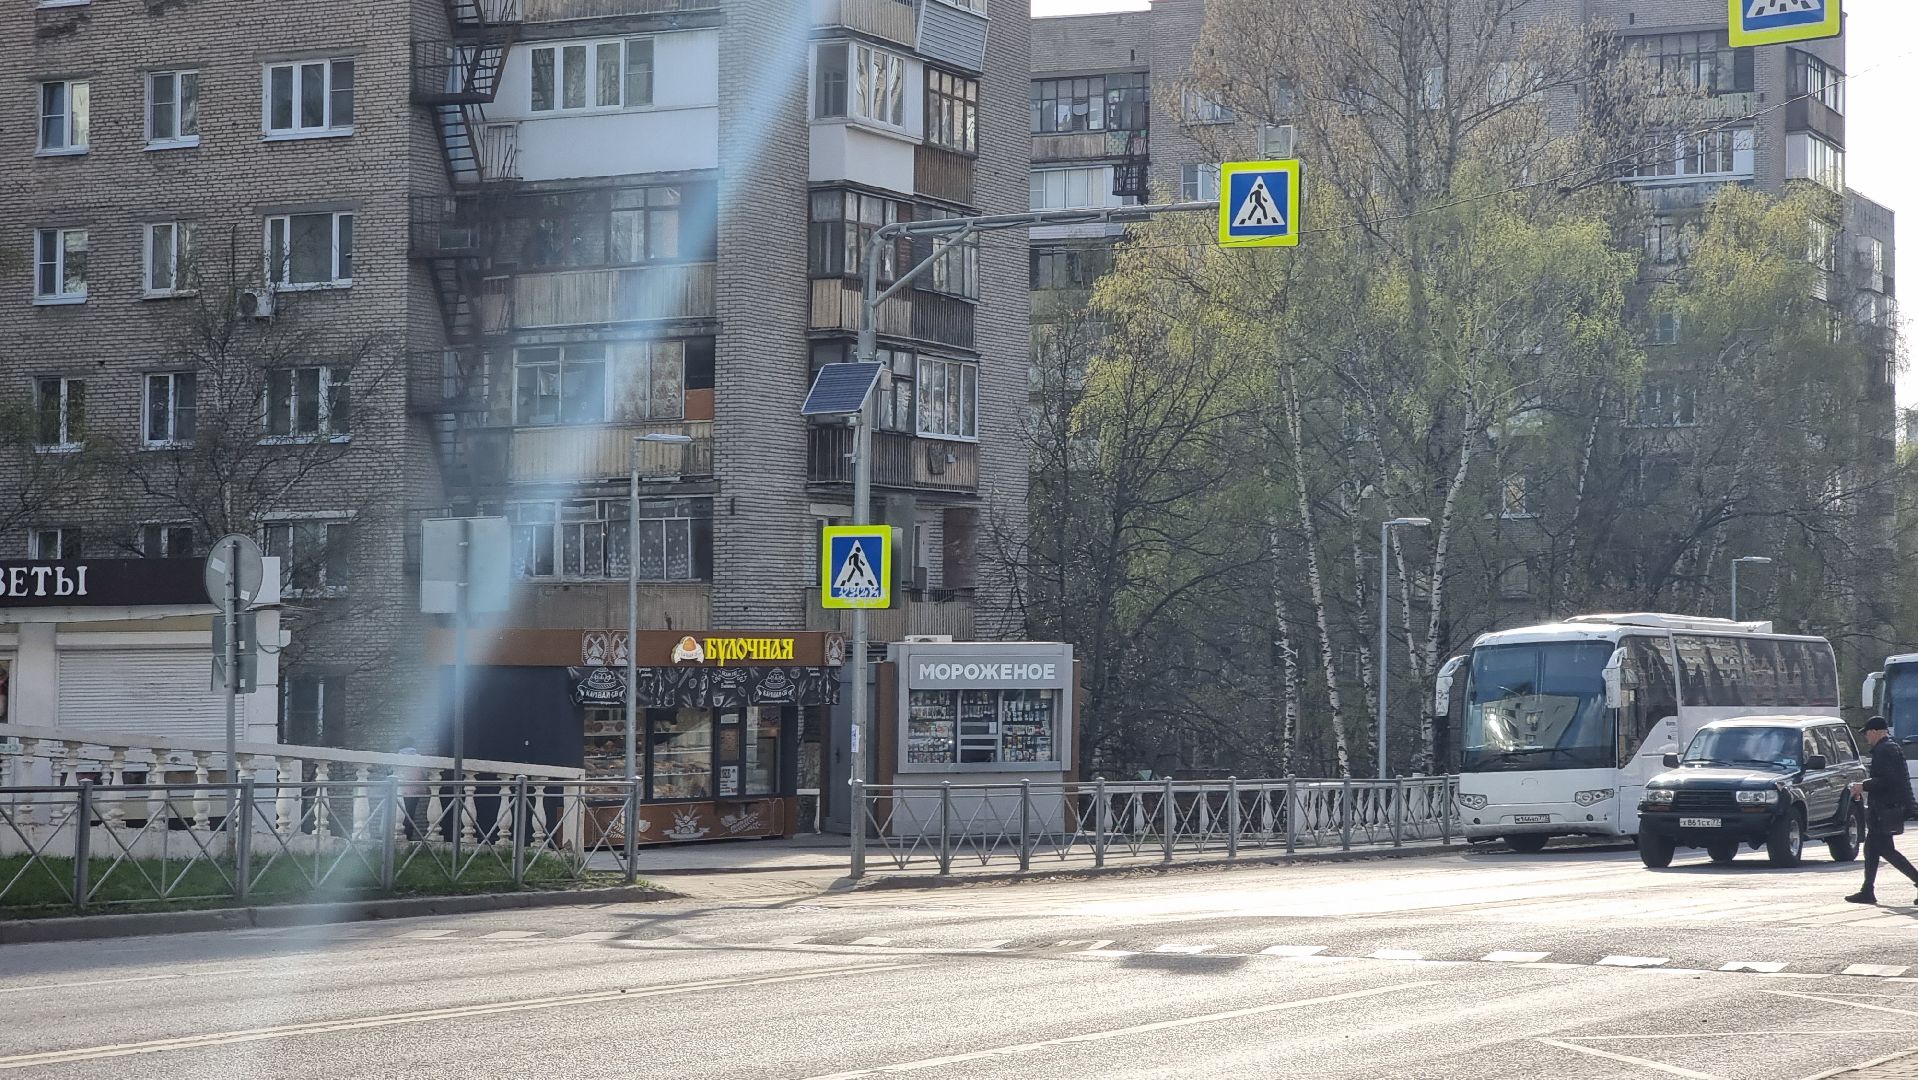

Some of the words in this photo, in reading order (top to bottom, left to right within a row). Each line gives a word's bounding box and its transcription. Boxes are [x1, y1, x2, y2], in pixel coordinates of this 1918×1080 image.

[0, 566, 88, 596] ЕТЫ
[703, 638, 795, 666] БУЛОЧНАЯ
[919, 663, 1056, 680] МОРОЖЕНОЕ
